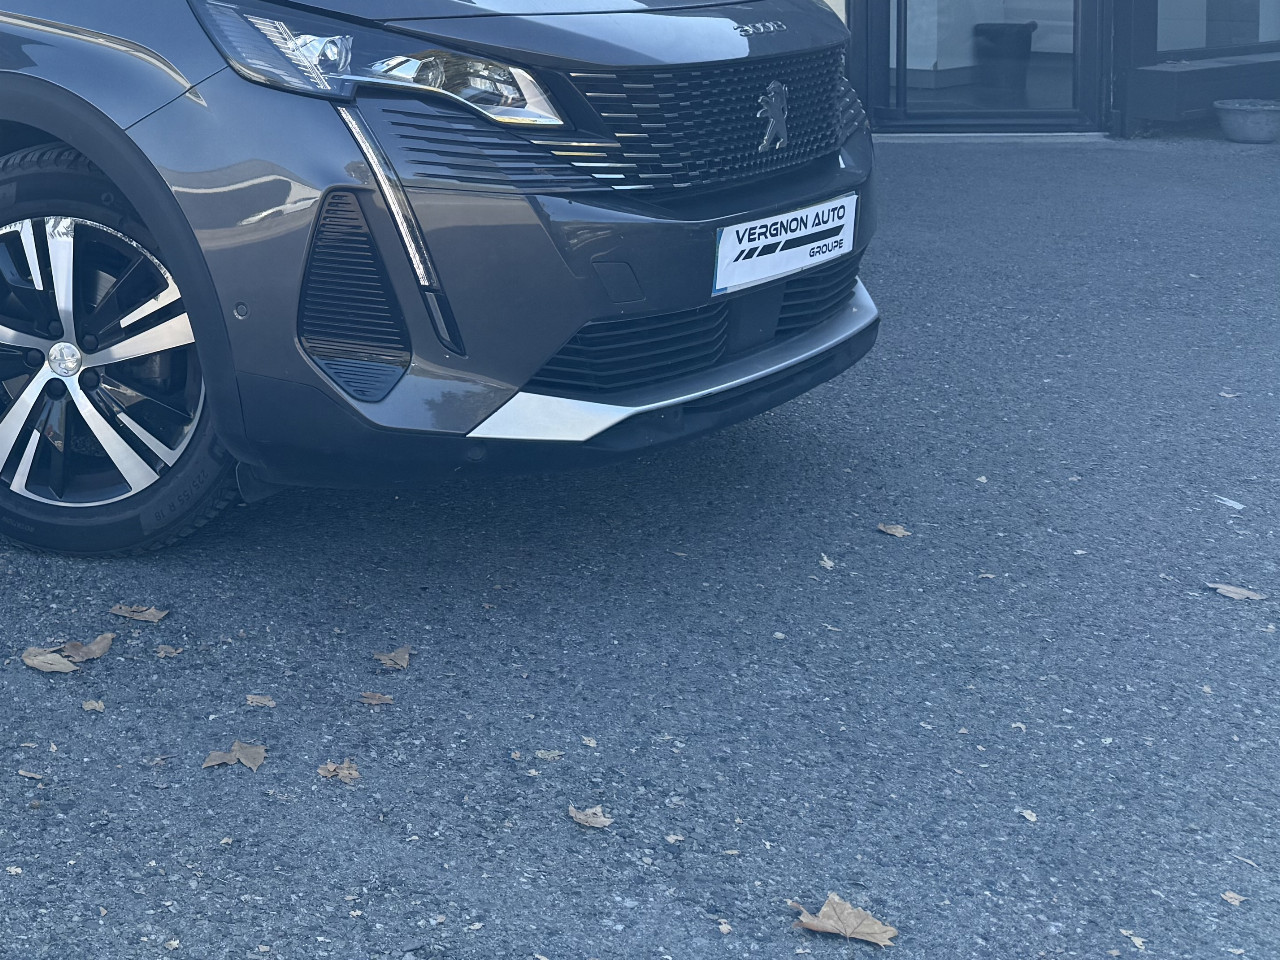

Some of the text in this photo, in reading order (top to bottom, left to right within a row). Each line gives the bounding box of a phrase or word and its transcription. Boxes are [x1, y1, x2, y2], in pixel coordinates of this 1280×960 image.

[735, 204, 846, 245] VERGNON AUTO
[808, 239, 844, 258] GROUPE
